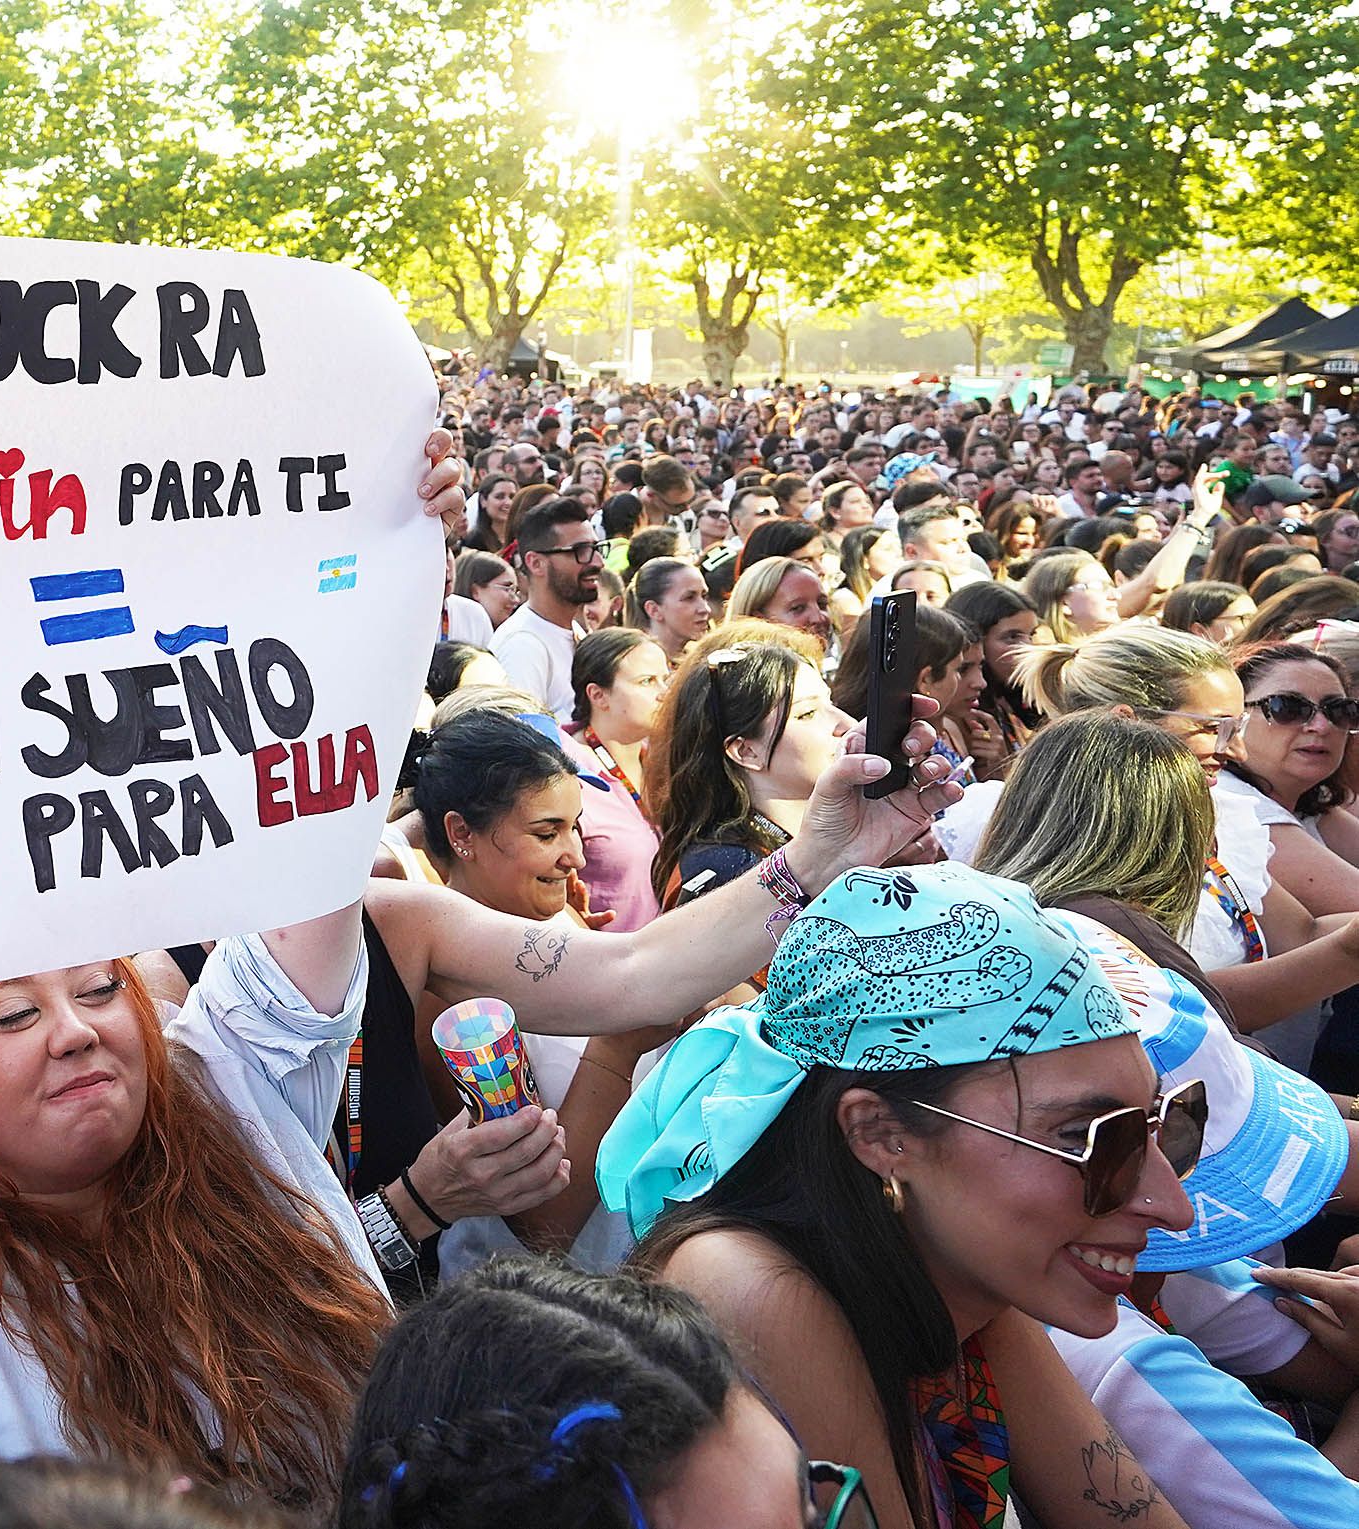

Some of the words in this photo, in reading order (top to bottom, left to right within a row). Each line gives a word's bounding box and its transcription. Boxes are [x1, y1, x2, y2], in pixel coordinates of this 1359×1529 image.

[156, 282, 266, 380] RA
[119, 459, 261, 526] PARA
[279, 453, 351, 513] TI
[21, 625, 314, 779] SUEÑO
[23, 774, 235, 893] PARA
[255, 724, 380, 828] ELLA
